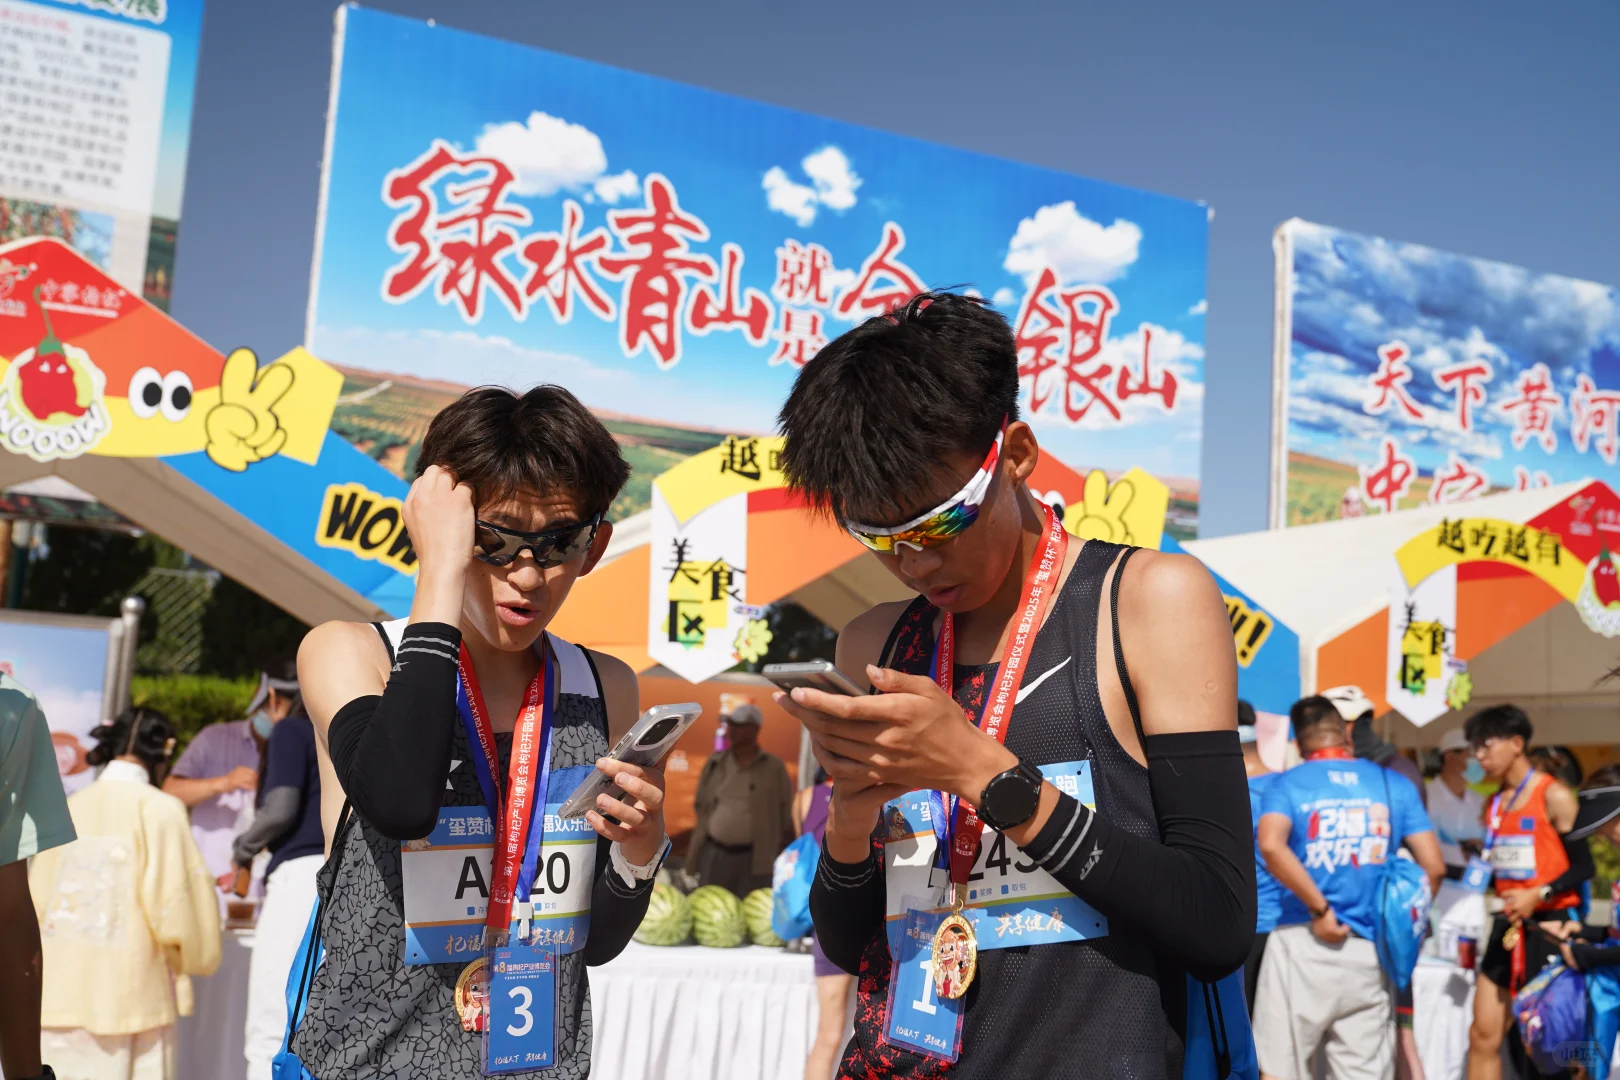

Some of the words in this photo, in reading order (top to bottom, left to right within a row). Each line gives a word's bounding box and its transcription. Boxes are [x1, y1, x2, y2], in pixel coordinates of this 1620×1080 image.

[662, 537, 747, 644] 美食区
[1398, 601, 1456, 690] 美食区
[506, 985, 534, 1037] 3
